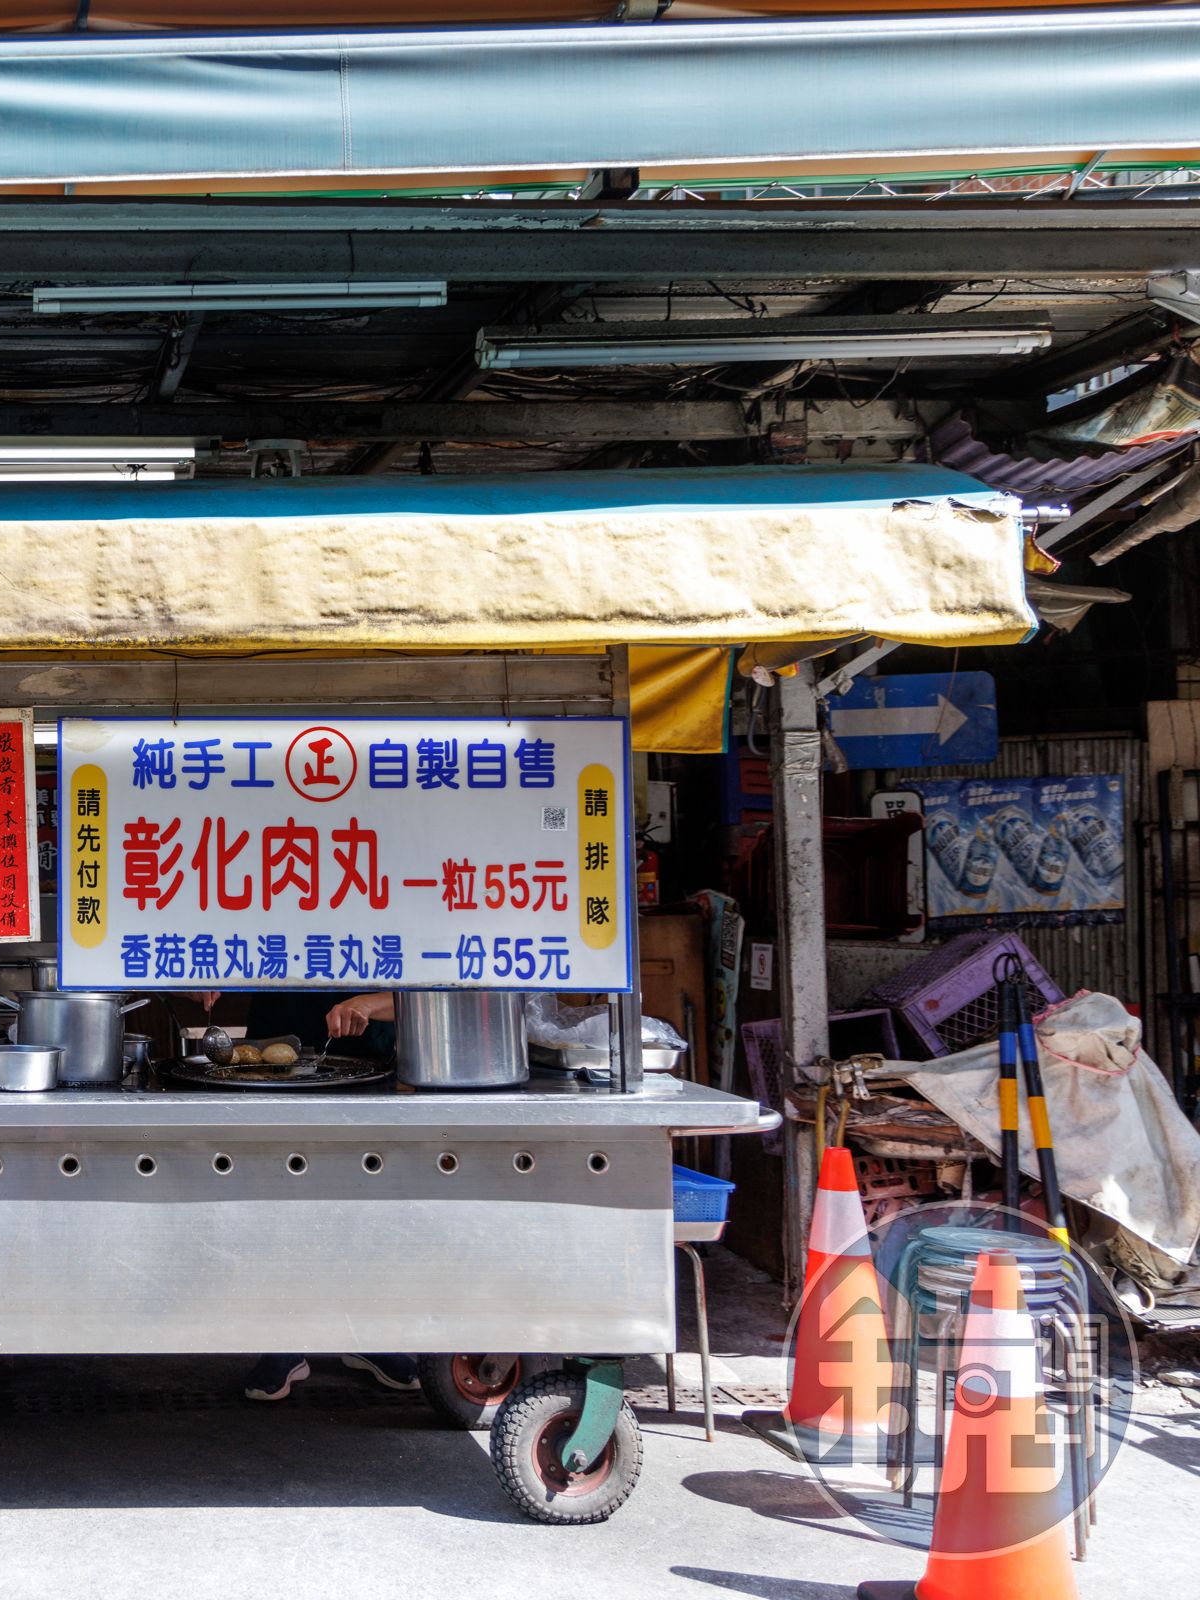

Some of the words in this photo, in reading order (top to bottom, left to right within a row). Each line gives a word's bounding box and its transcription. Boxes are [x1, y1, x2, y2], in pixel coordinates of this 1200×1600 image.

[132, 737, 275, 790] 純手工
[368, 738, 557, 789] 自製自售
[77, 788, 102, 926] 請先付款
[122, 816, 390, 912] 彰化肉丸
[403, 858, 568, 913] 一粒55元
[584, 788, 610, 926] 請排隊
[421, 934, 570, 981] 一份55元
